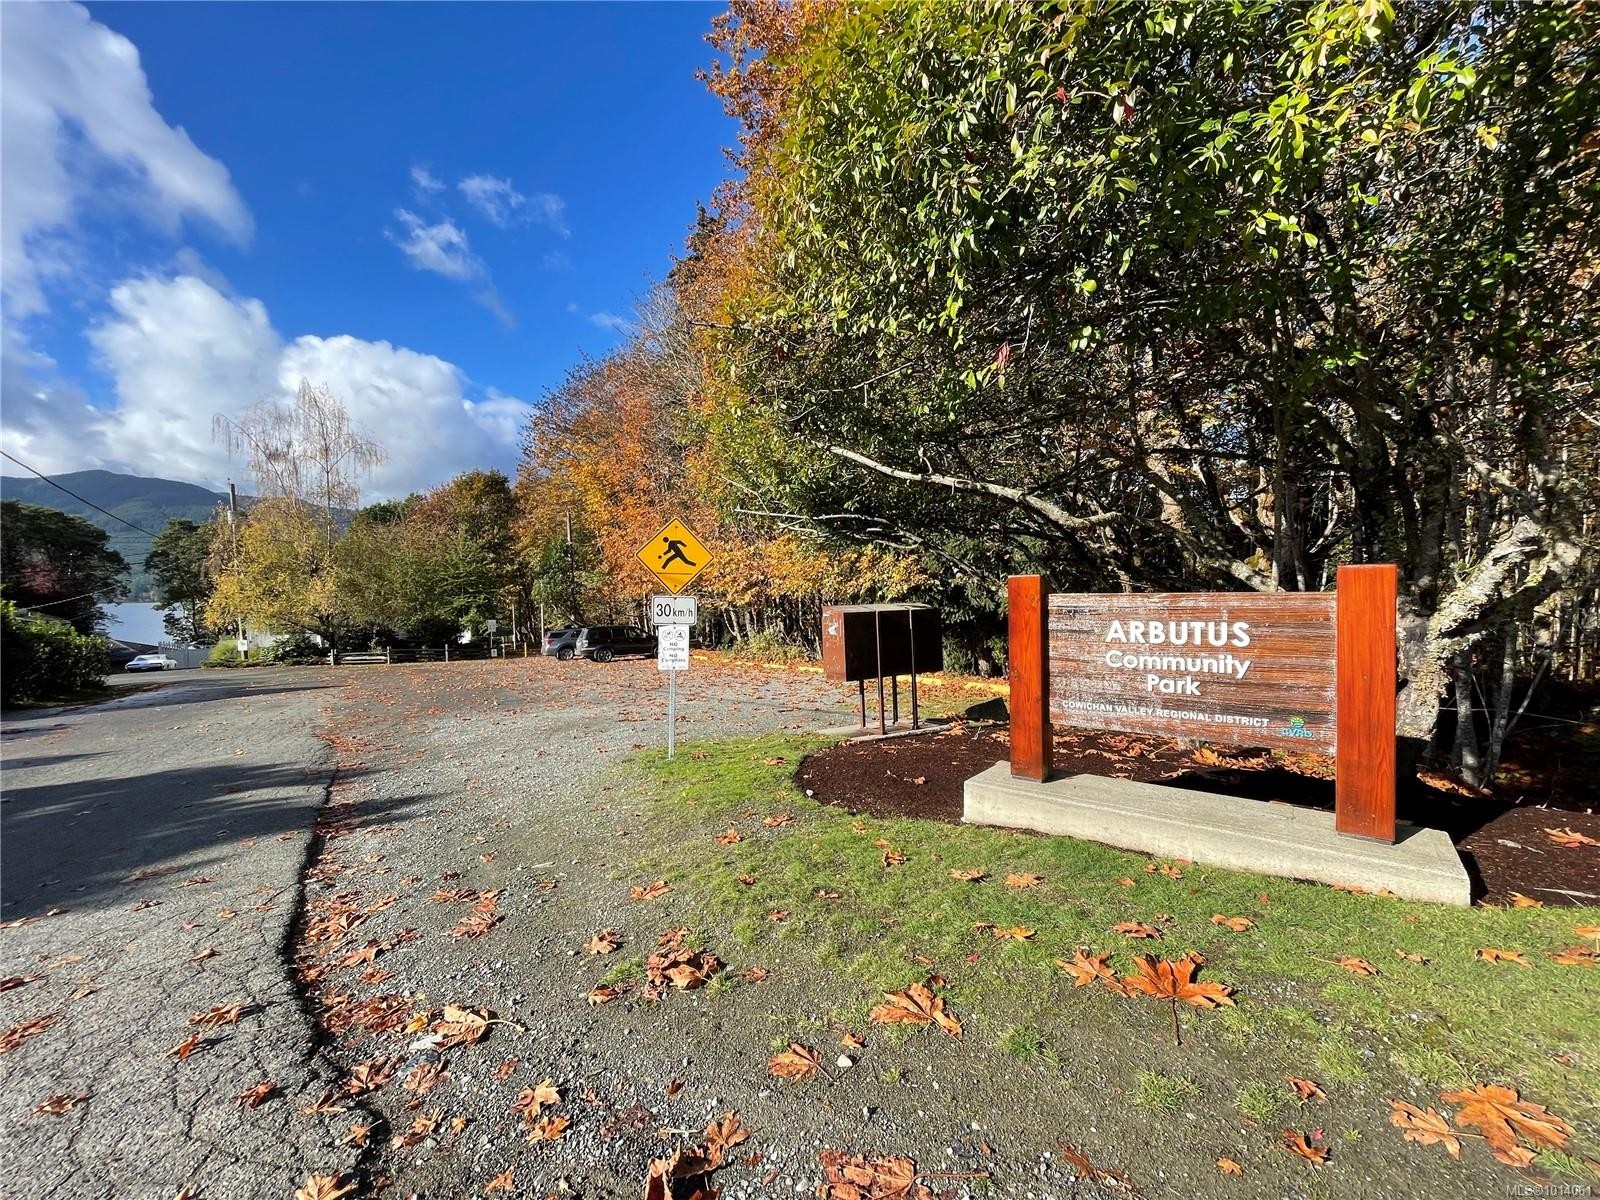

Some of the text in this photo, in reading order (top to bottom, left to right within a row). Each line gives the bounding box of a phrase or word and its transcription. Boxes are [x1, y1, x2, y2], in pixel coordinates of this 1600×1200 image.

[656, 603, 693, 617] 30 km/h
[1105, 619, 1250, 647] ARBUTUS
[1104, 650, 1251, 679] Community
[1146, 674, 1201, 696] Park
[1062, 700, 1269, 727] COWICHAN VALLEY REGIONAL DISTRICT
